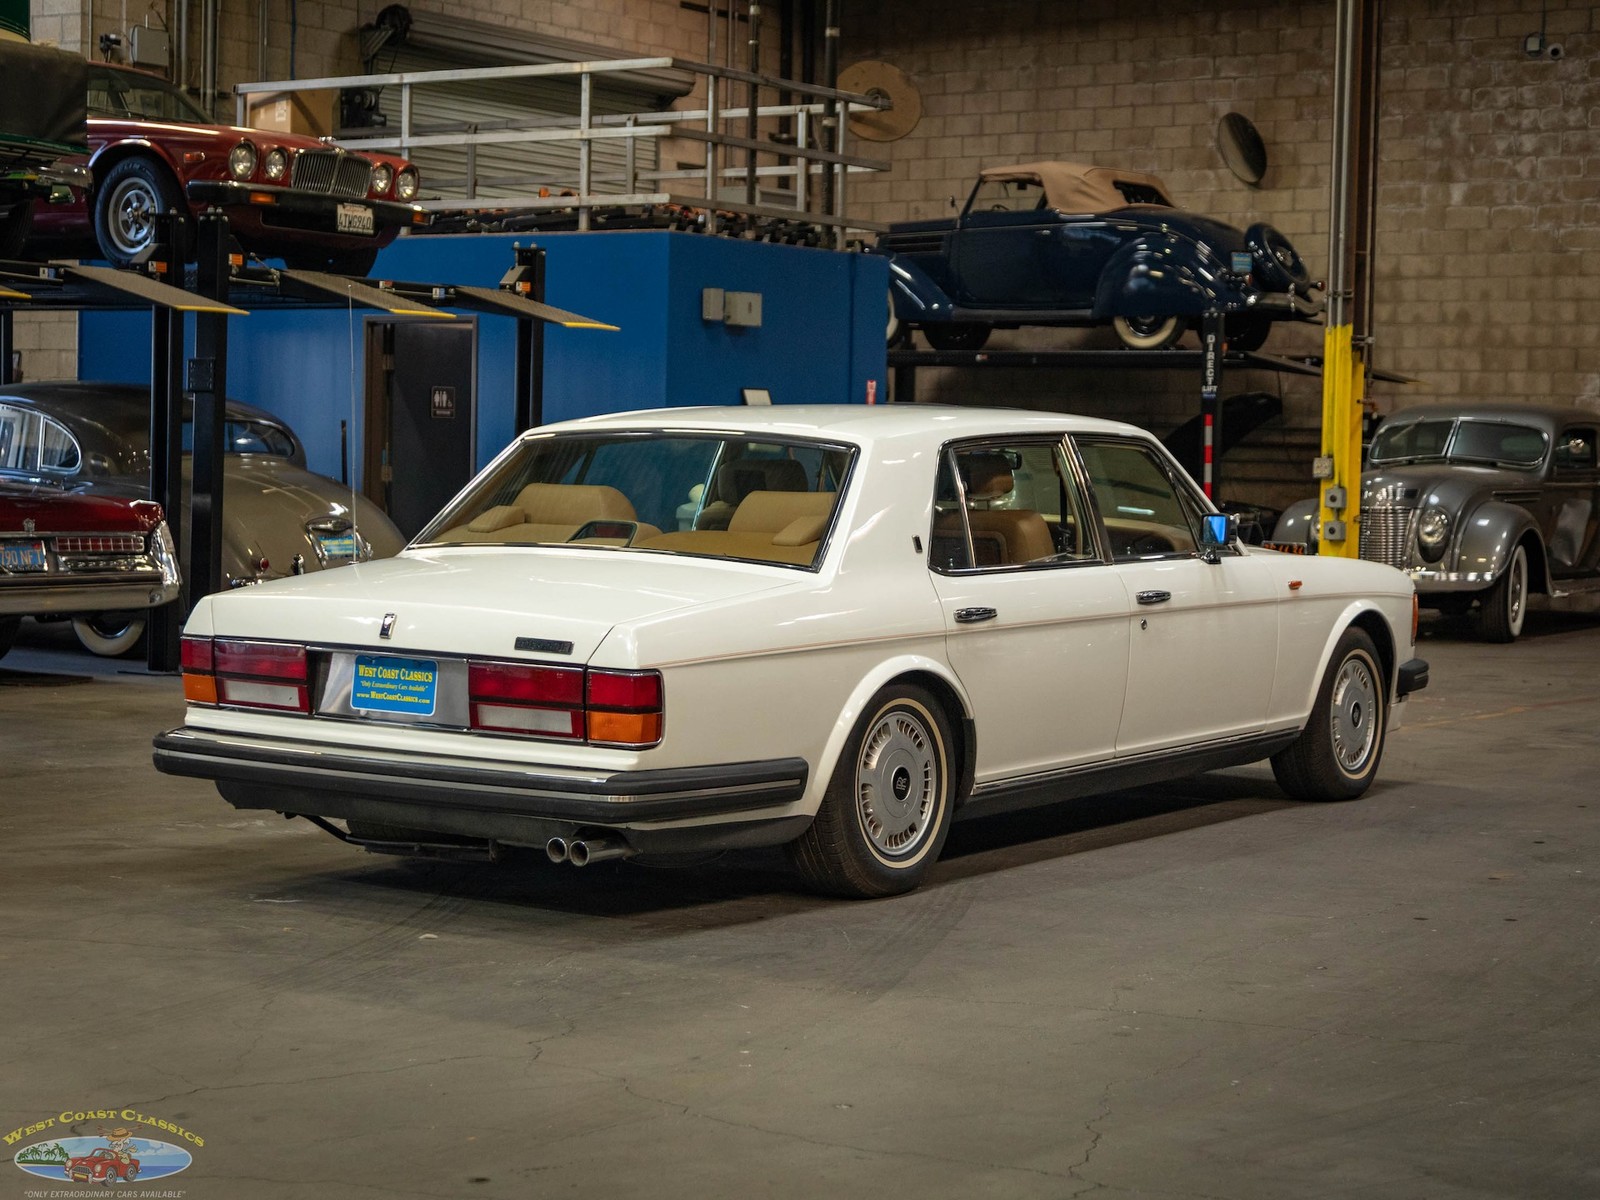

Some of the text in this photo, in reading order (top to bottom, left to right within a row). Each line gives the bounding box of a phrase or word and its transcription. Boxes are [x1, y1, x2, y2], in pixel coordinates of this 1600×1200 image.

[1206, 334, 1216, 386] DIRECT
[358, 664, 433, 682] WEST COAST CLASSICS
